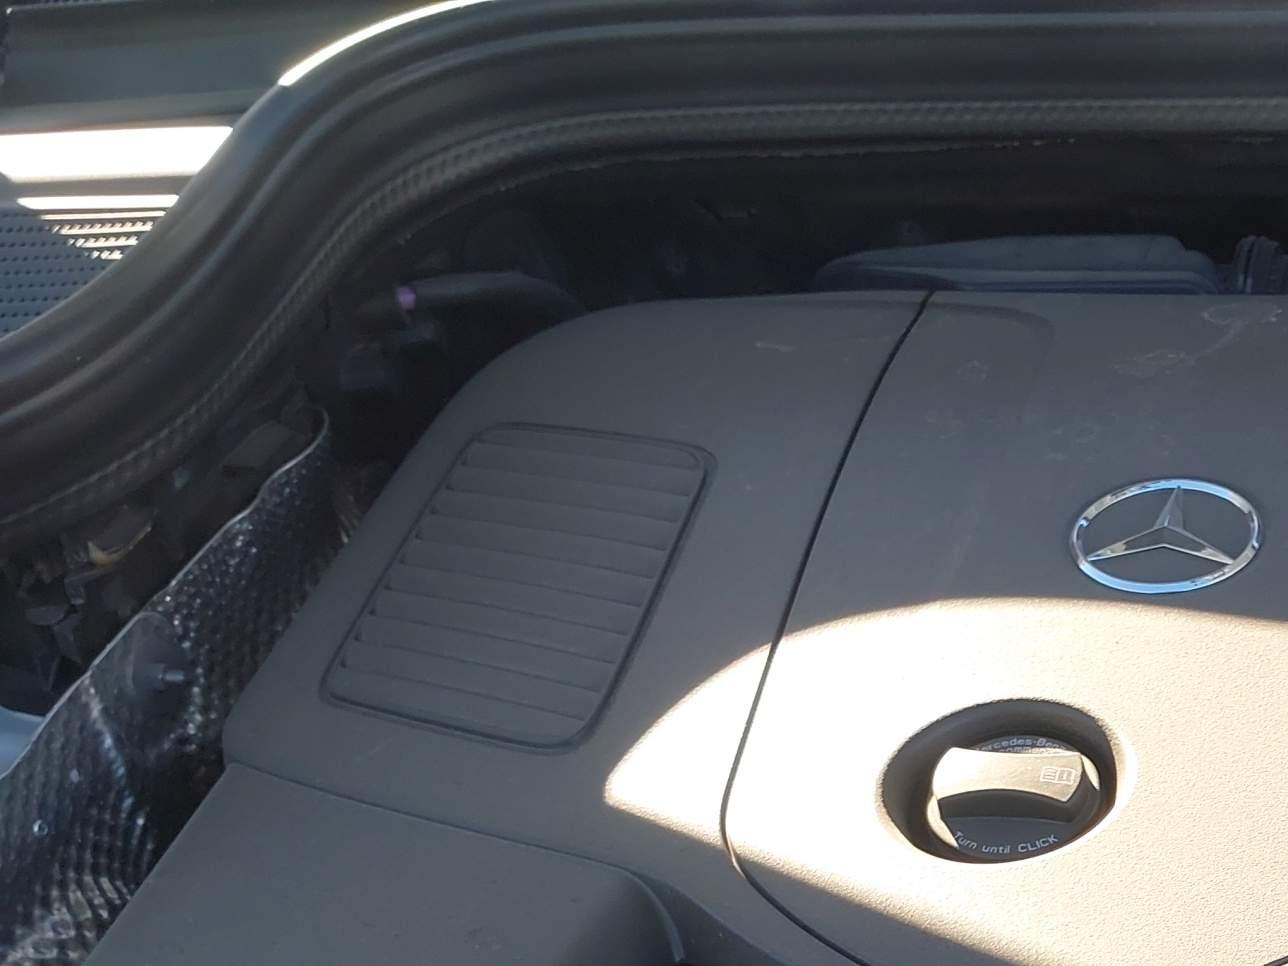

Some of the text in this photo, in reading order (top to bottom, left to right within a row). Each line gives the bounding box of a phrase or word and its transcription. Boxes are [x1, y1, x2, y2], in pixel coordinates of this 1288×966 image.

[954, 831, 1059, 854] Turn until CLICK
